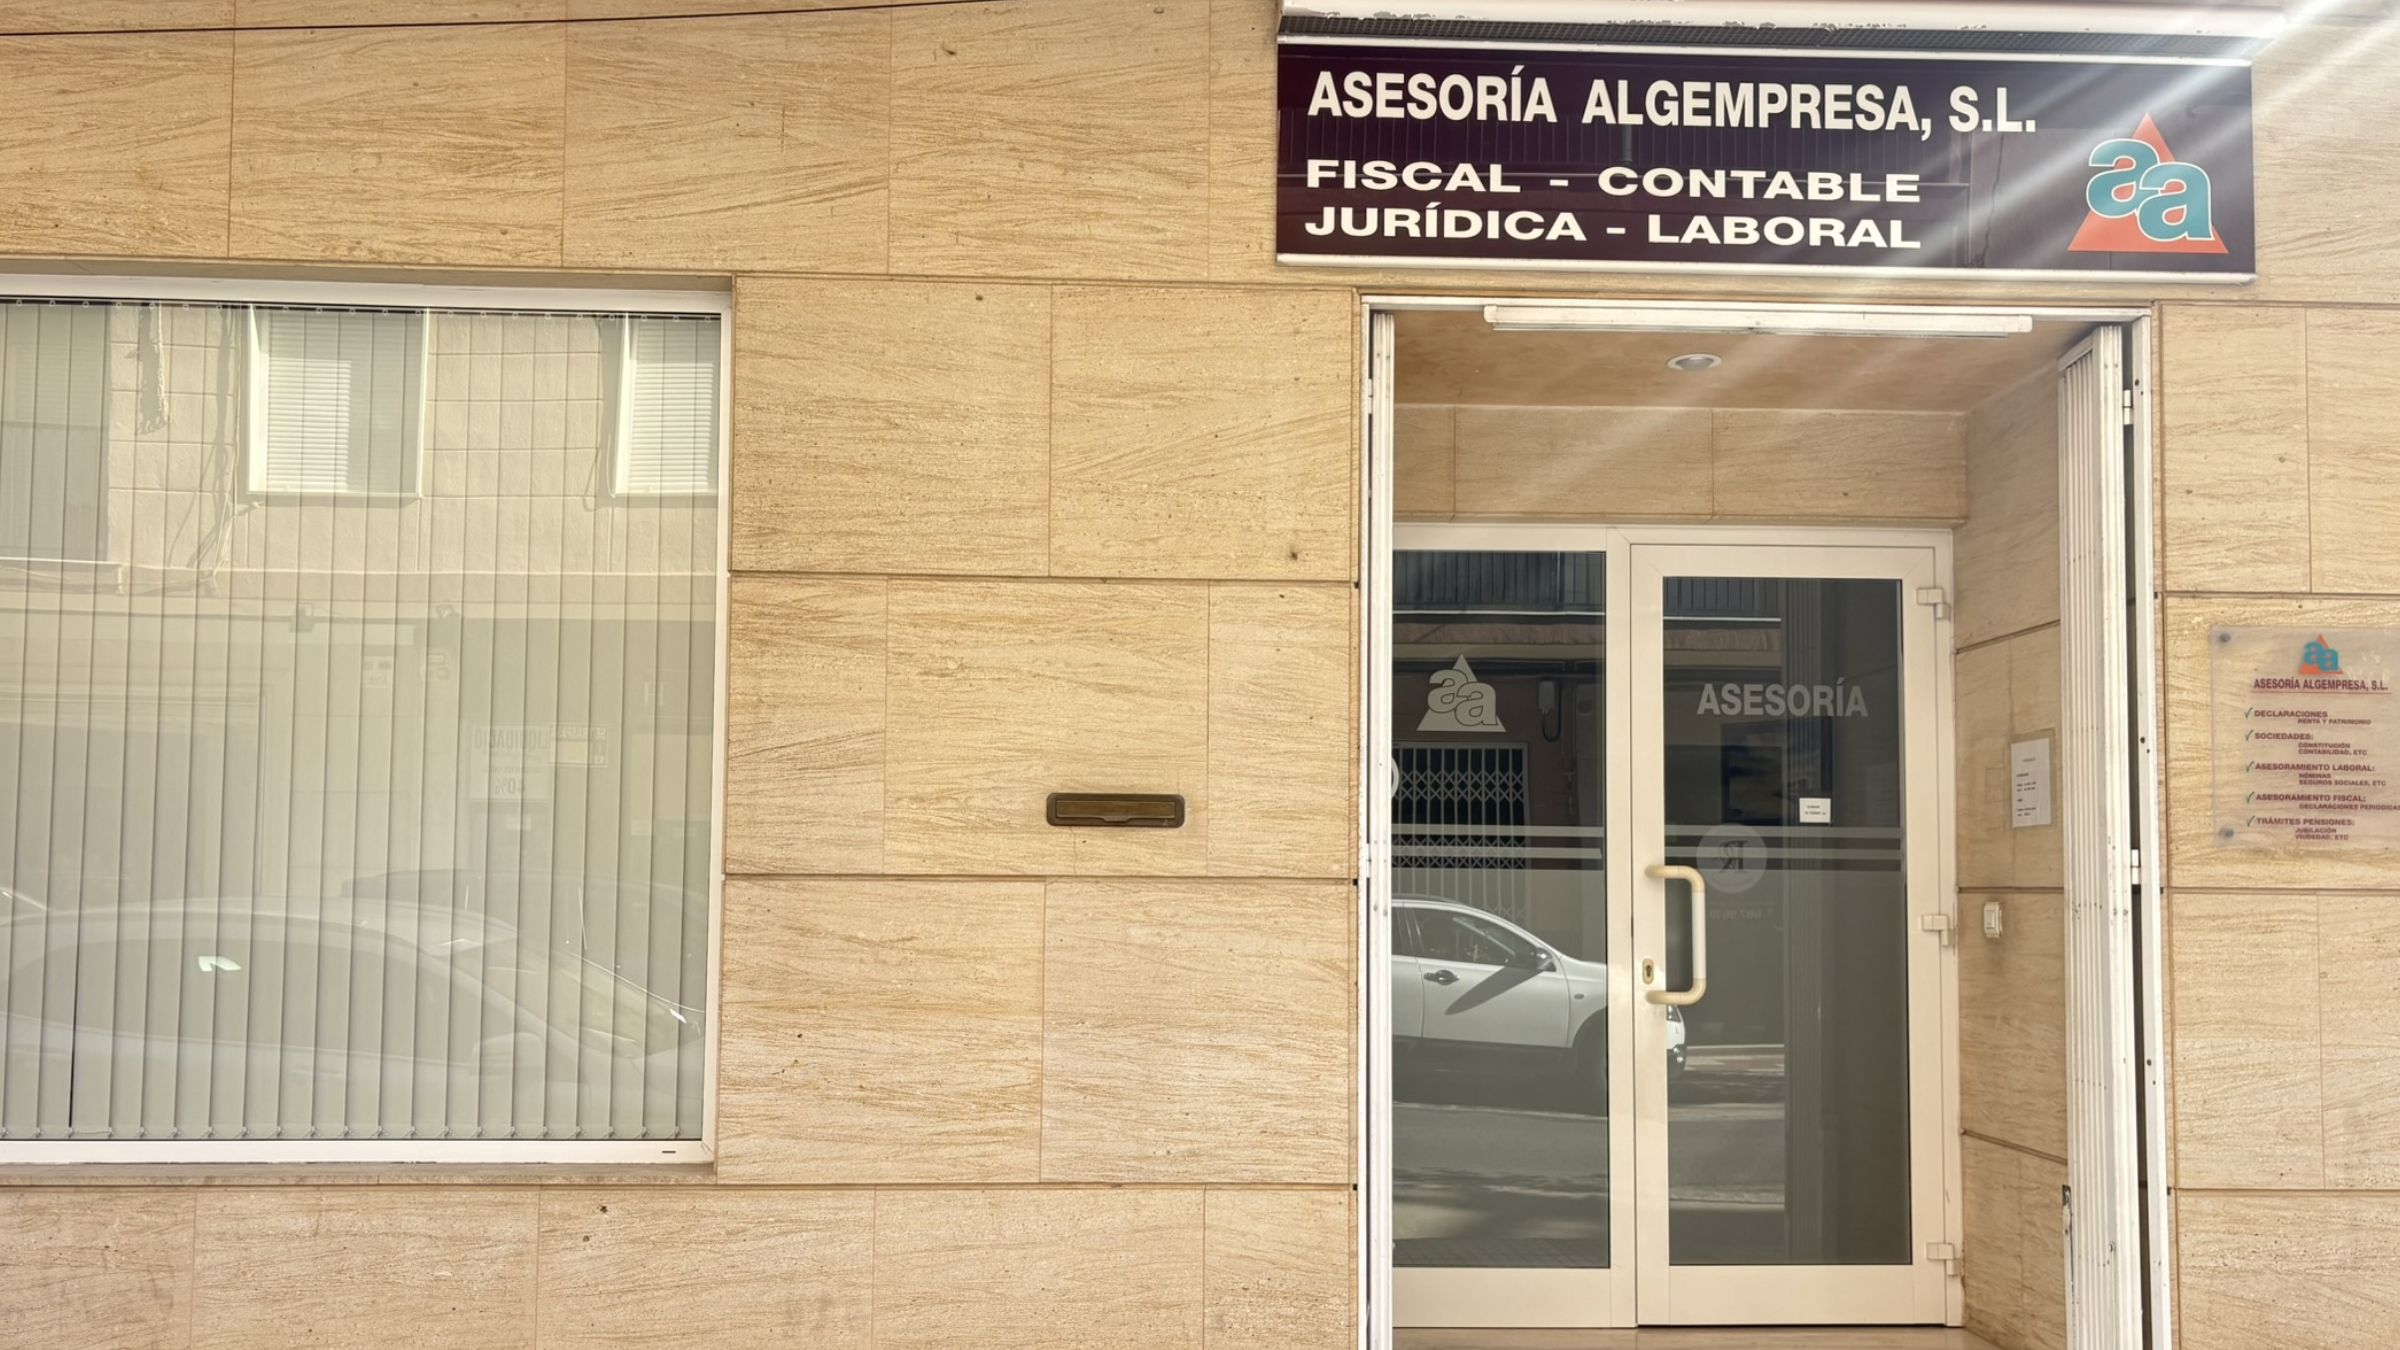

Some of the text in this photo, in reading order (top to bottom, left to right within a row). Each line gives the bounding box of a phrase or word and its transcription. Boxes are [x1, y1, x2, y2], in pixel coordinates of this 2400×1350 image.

[1308, 65, 2036, 141] ASESORÍA ALGEMPRESA, S.L.
[1307, 159, 1521, 193] FISCAL
[1598, 166, 1921, 203] CONTABLE
[1305, 201, 1587, 241] JURÍDICA
[1648, 214, 1922, 250] LABORAL
[2253, 676, 2388, 692] ASESORÍA ALGEMPRESA, S.L.
[1697, 677, 1869, 717] ASESORÍA
[2254, 710, 2328, 718] DECLARACIONES
[2254, 732, 2314, 740] SOCIEDADES:
[2255, 763, 2375, 772] ASESORAMIENTO LABORAL:
[2256, 794, 2330, 802] ASESORAMIENTO
